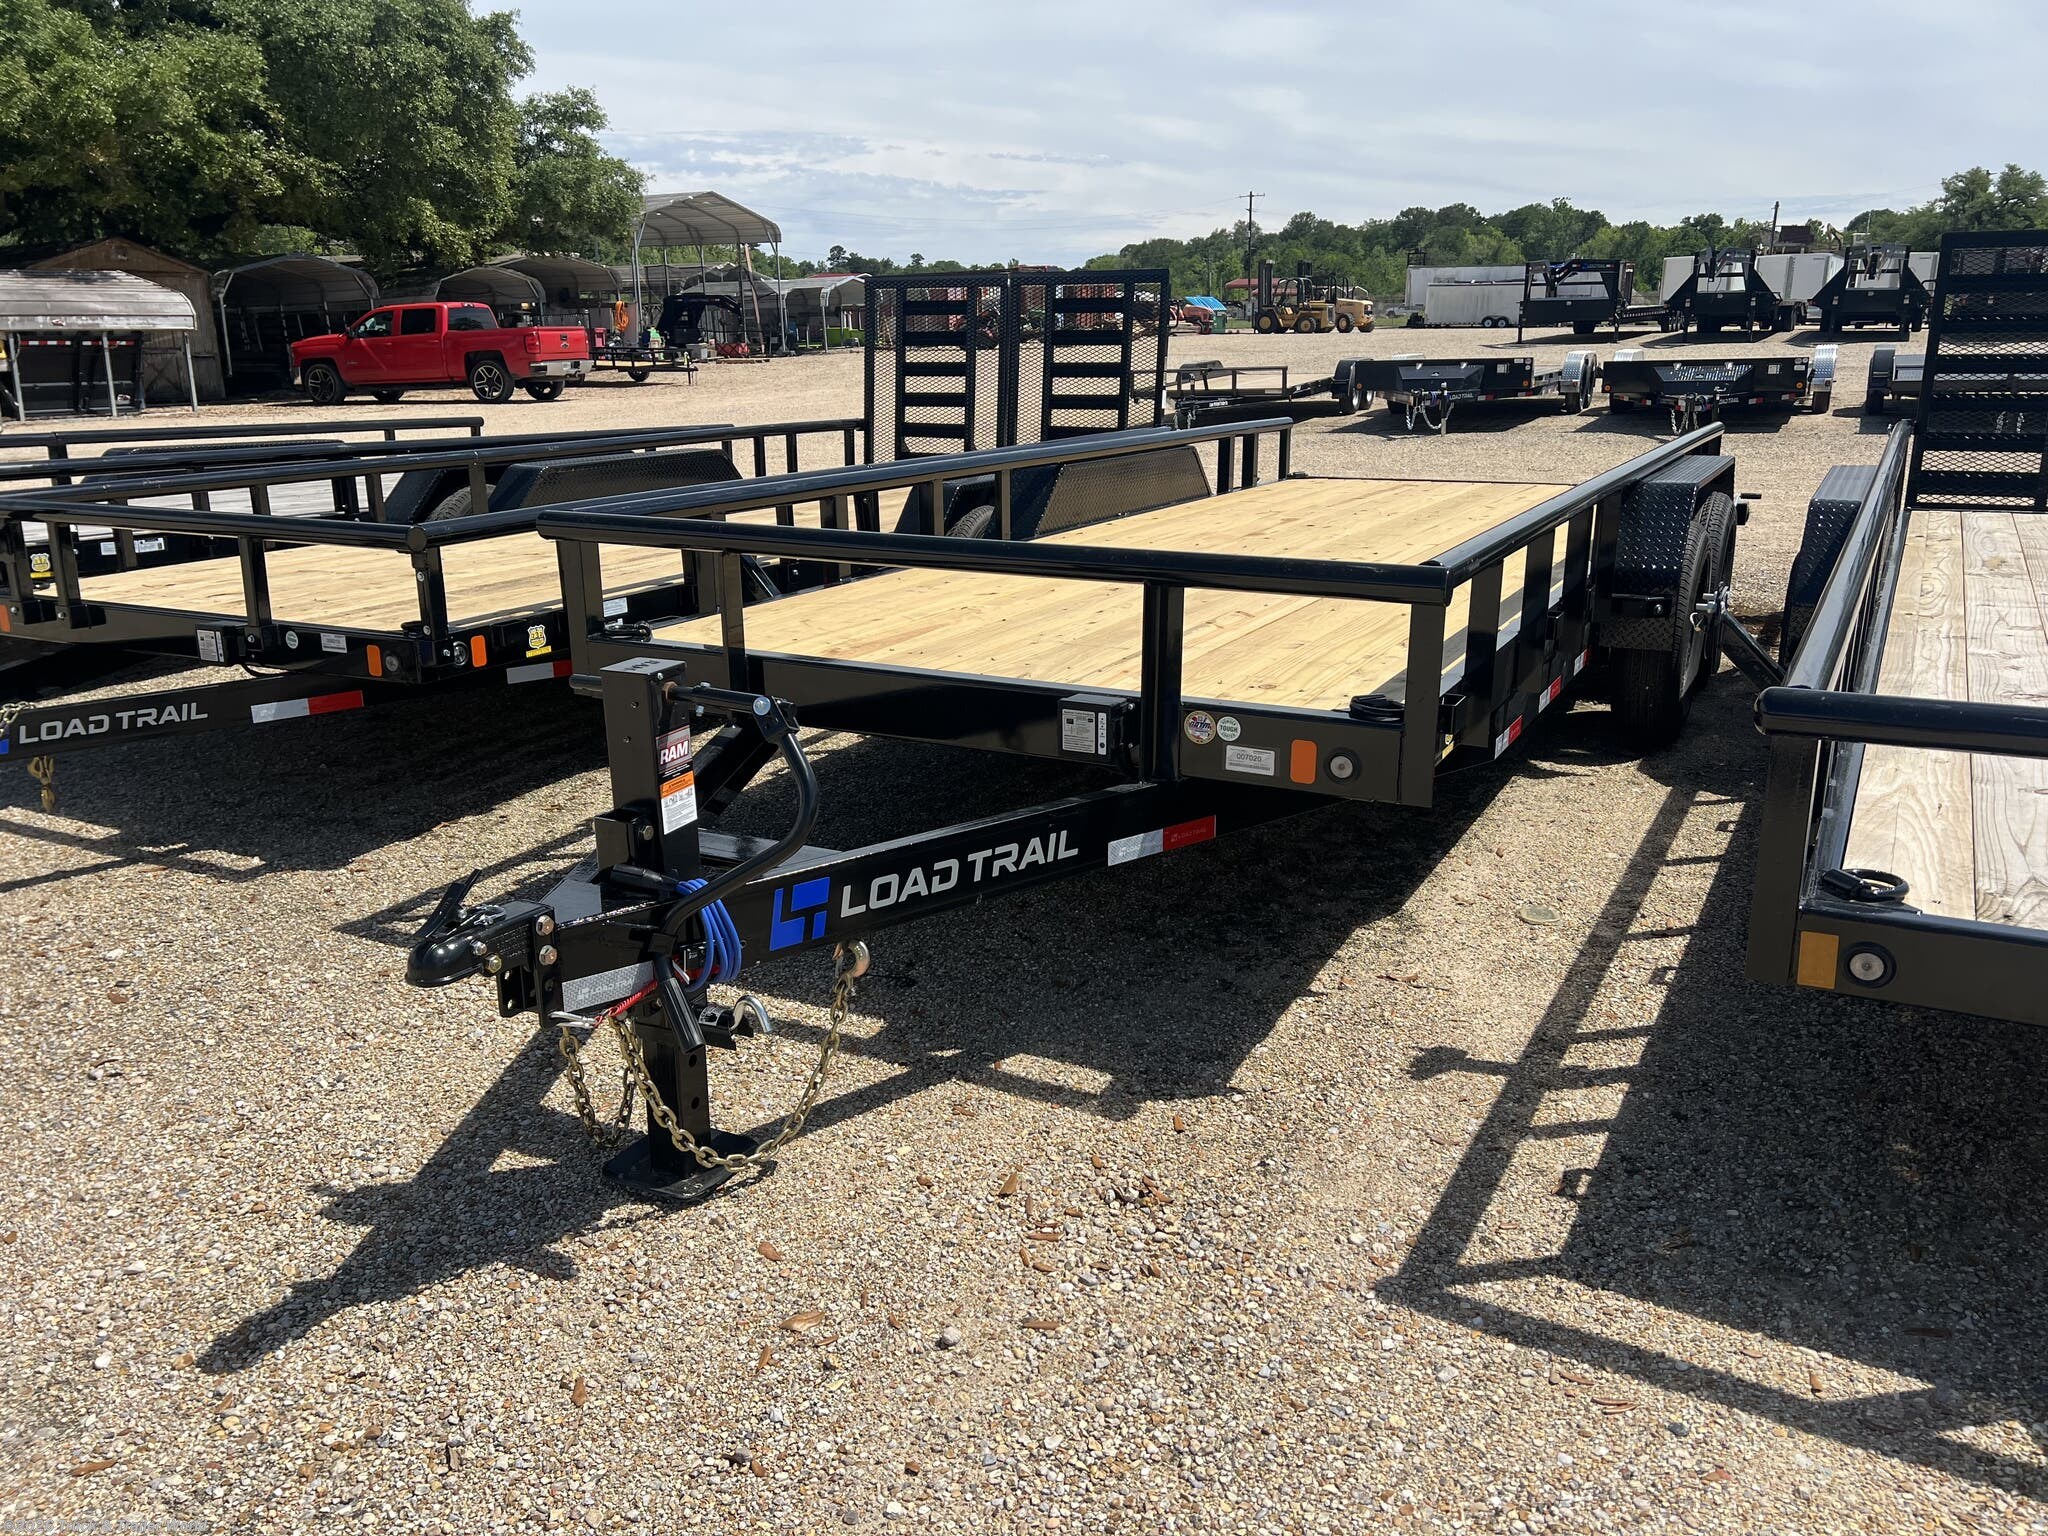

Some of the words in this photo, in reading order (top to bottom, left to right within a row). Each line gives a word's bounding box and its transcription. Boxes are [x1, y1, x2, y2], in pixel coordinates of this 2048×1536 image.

[18, 714, 110, 745] LOAD
[115, 702, 209, 730] TRAIL
[1219, 724, 1238, 733] TOUGH
[659, 739, 690, 766] RAM
[1236, 752, 1262, 763] 007020
[839, 858, 960, 919] LOAD
[965, 829, 1080, 883] TRAIL
